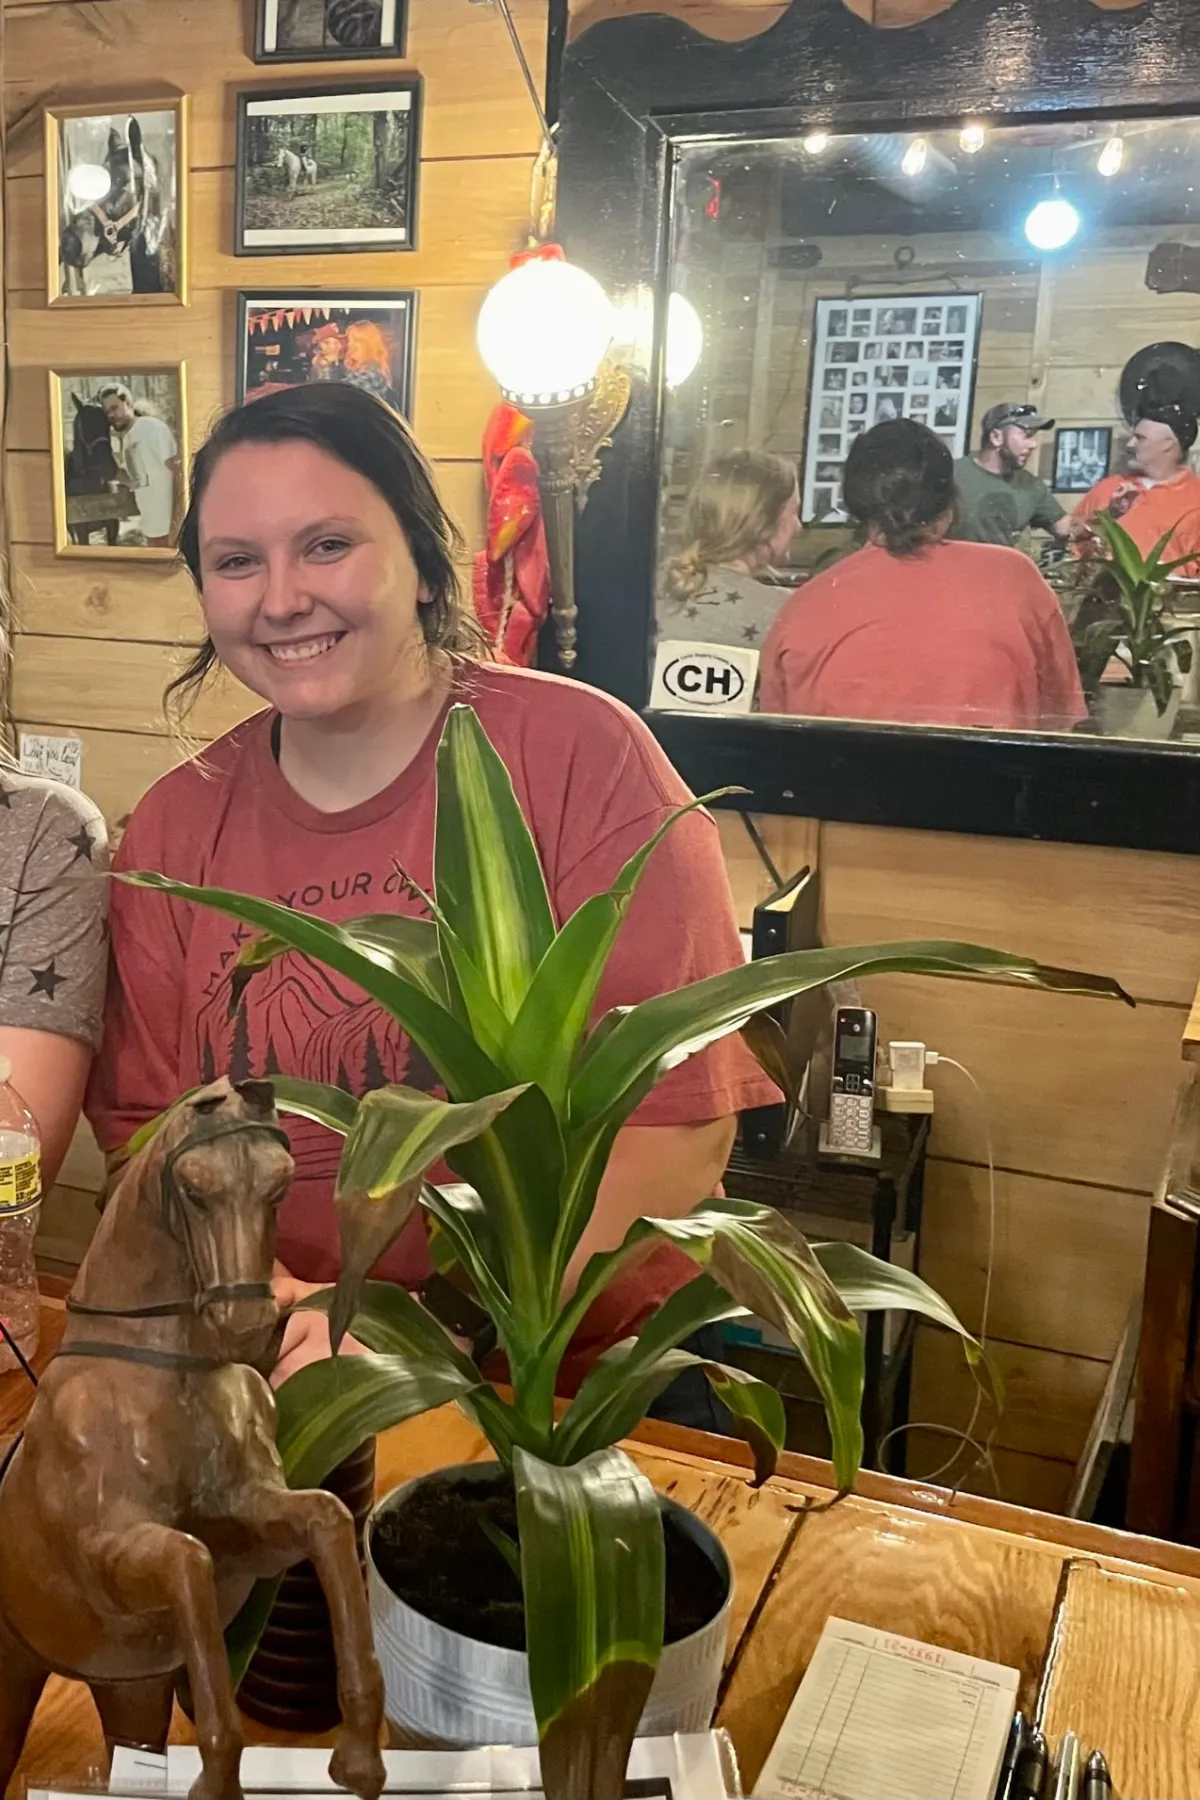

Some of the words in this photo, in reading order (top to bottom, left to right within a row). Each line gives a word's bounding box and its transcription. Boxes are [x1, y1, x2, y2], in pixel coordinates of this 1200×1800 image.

[677, 664, 731, 695] CH
[202, 921, 252, 997] MAK
[276, 872, 373, 908] YOUR
